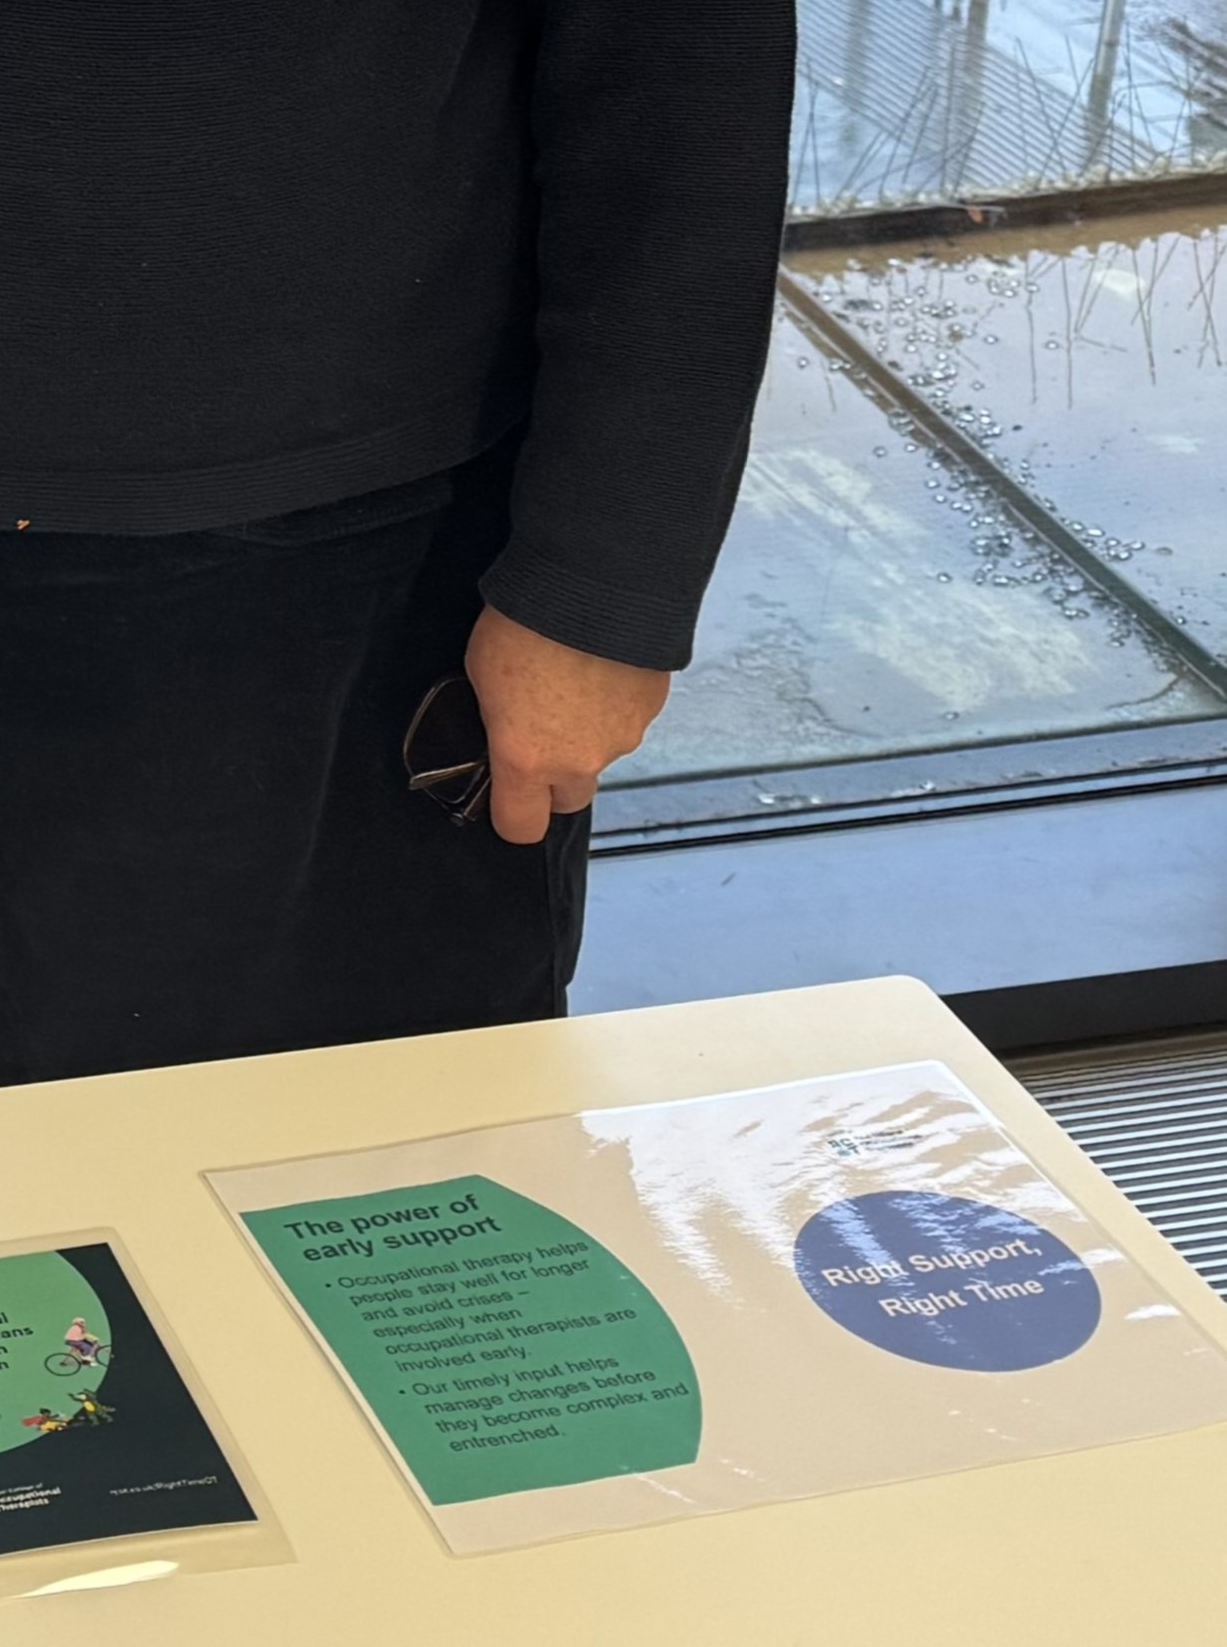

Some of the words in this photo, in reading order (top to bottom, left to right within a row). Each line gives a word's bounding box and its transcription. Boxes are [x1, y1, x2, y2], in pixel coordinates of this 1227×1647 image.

[283, 1219, 344, 1239] The
[350, 1204, 440, 1235] power
[449, 1194, 479, 1214] of
[303, 1238, 374, 1261] early
[382, 1216, 502, 1249] support
[337, 1261, 460, 1289] Occupational
[462, 1250, 532, 1271] therapy
[536, 1240, 589, 1260] helps
[349, 1286, 413, 1306] people
[418, 1280, 457, 1297] stay
[458, 1270, 499, 1290] well
[500, 1268, 528, 1282] for
[530, 1258, 590, 1278] longer
[821, 1260, 909, 1287] Right
[908, 1238, 1042, 1275] Support,
[360, 1306, 397, 1322] and
[402, 1298, 455, 1317] avoid
[457, 1290, 514, 1308] crises
[878, 1290, 968, 1317] Right
[964, 1276, 1045, 1303] Time
[372, 1315, 466, 1338] especially
[469, 1308, 523, 1326] when
[385, 1328, 505, 1356] occupational
[507, 1314, 602, 1339] therapists
[604, 1308, 638, 1323] are
[395, 1352, 476, 1373] involved
[480, 1344, 531, 1362] early.
[412, 1380, 449, 1396] Our
[452, 1369, 511, 1392] timely
[515, 1361, 566, 1384] input
[566, 1355, 620, 1375] helps
[423, 1393, 504, 1415] manage
[508, 1378, 591, 1403] changes
[592, 1369, 657, 1389] before
[435, 1416, 479, 1435] they
[481, 1405, 562, 1428] become
[566, 1393, 648, 1415] complex
[650, 1382, 690, 1402] and
[449, 1424, 566, 1453] entrenched.
